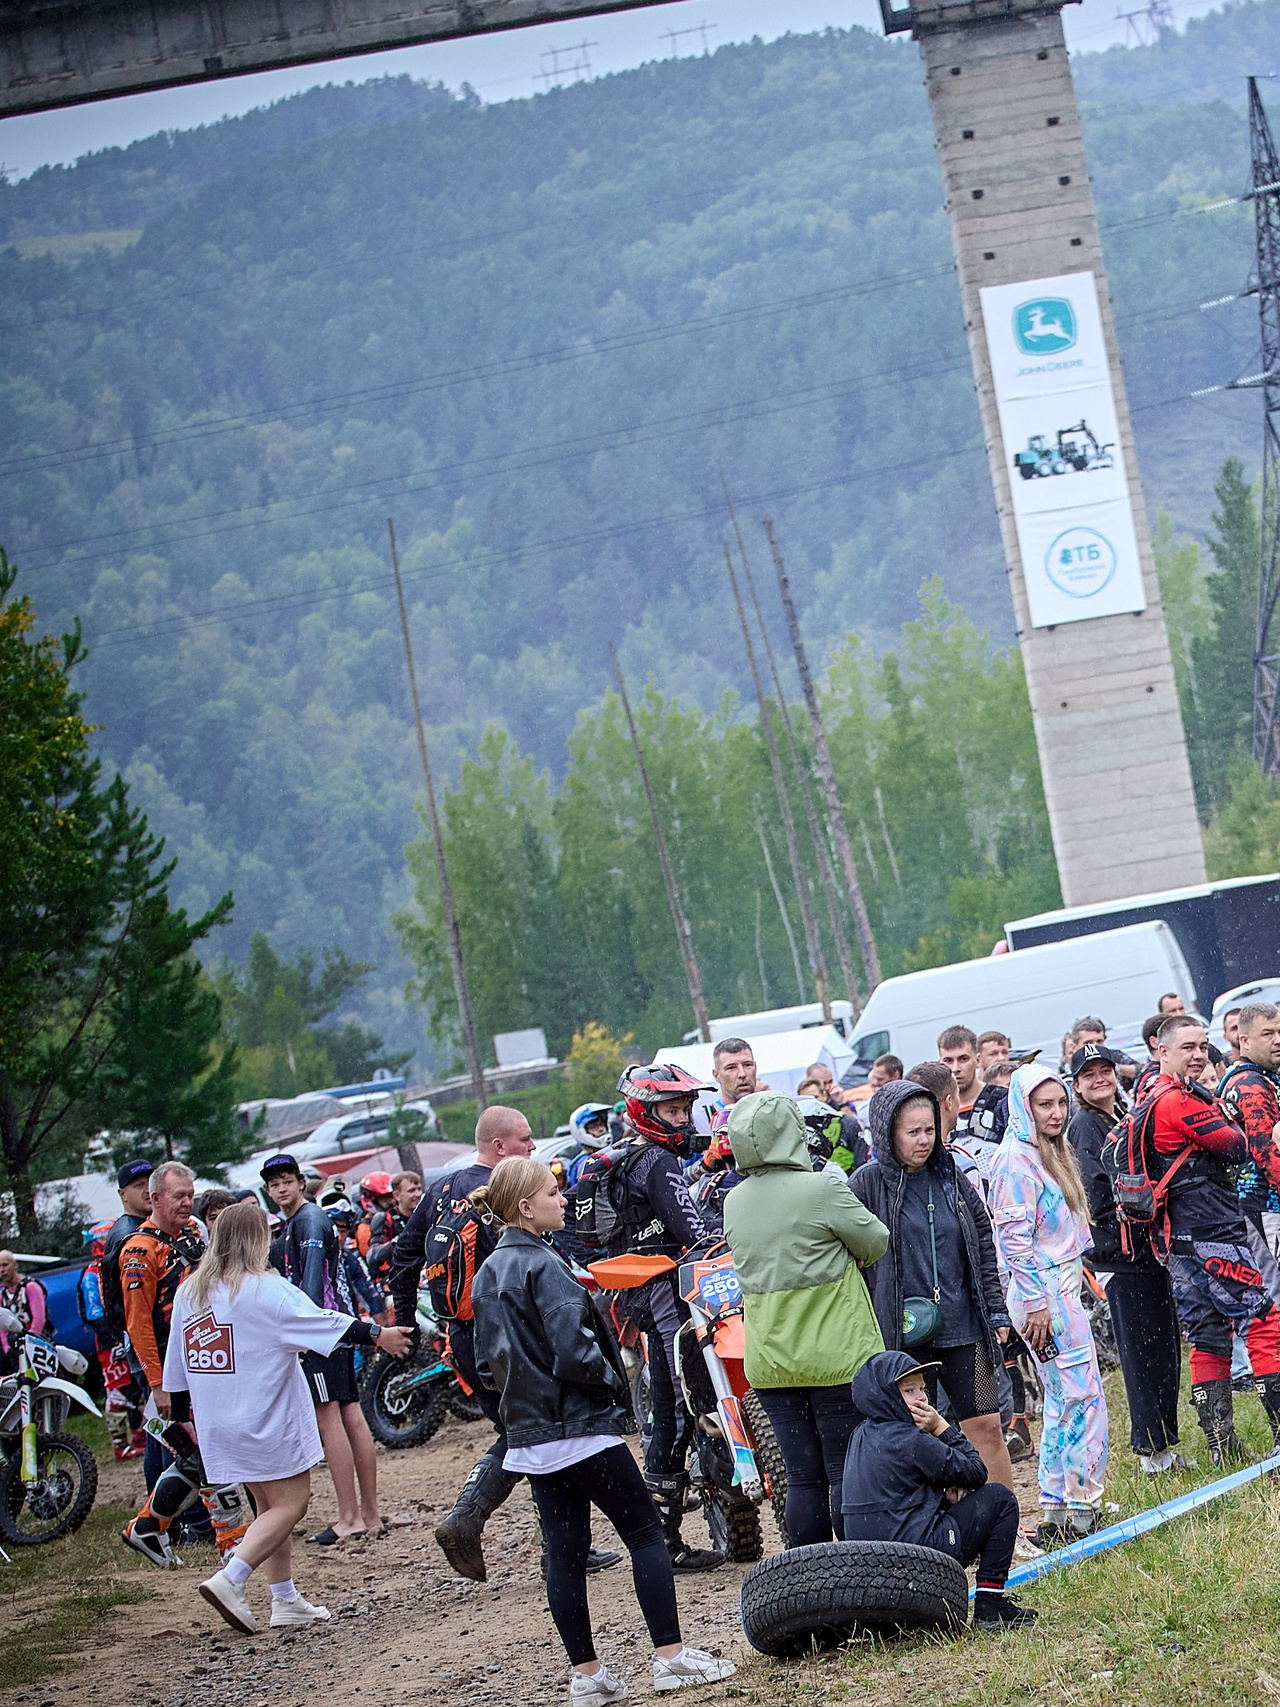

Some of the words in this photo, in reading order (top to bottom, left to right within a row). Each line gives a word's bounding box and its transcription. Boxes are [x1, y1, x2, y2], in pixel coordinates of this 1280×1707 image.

[1017, 365, 1046, 376] JOHN
[1047, 359, 1084, 371] DEERE
[1072, 543, 1100, 562] ТБ
[434, 1233, 448, 1243] KTM
[702, 1278, 739, 1297] 250
[32, 1346, 57, 1373] 24
[188, 1349, 228, 1369] 260
